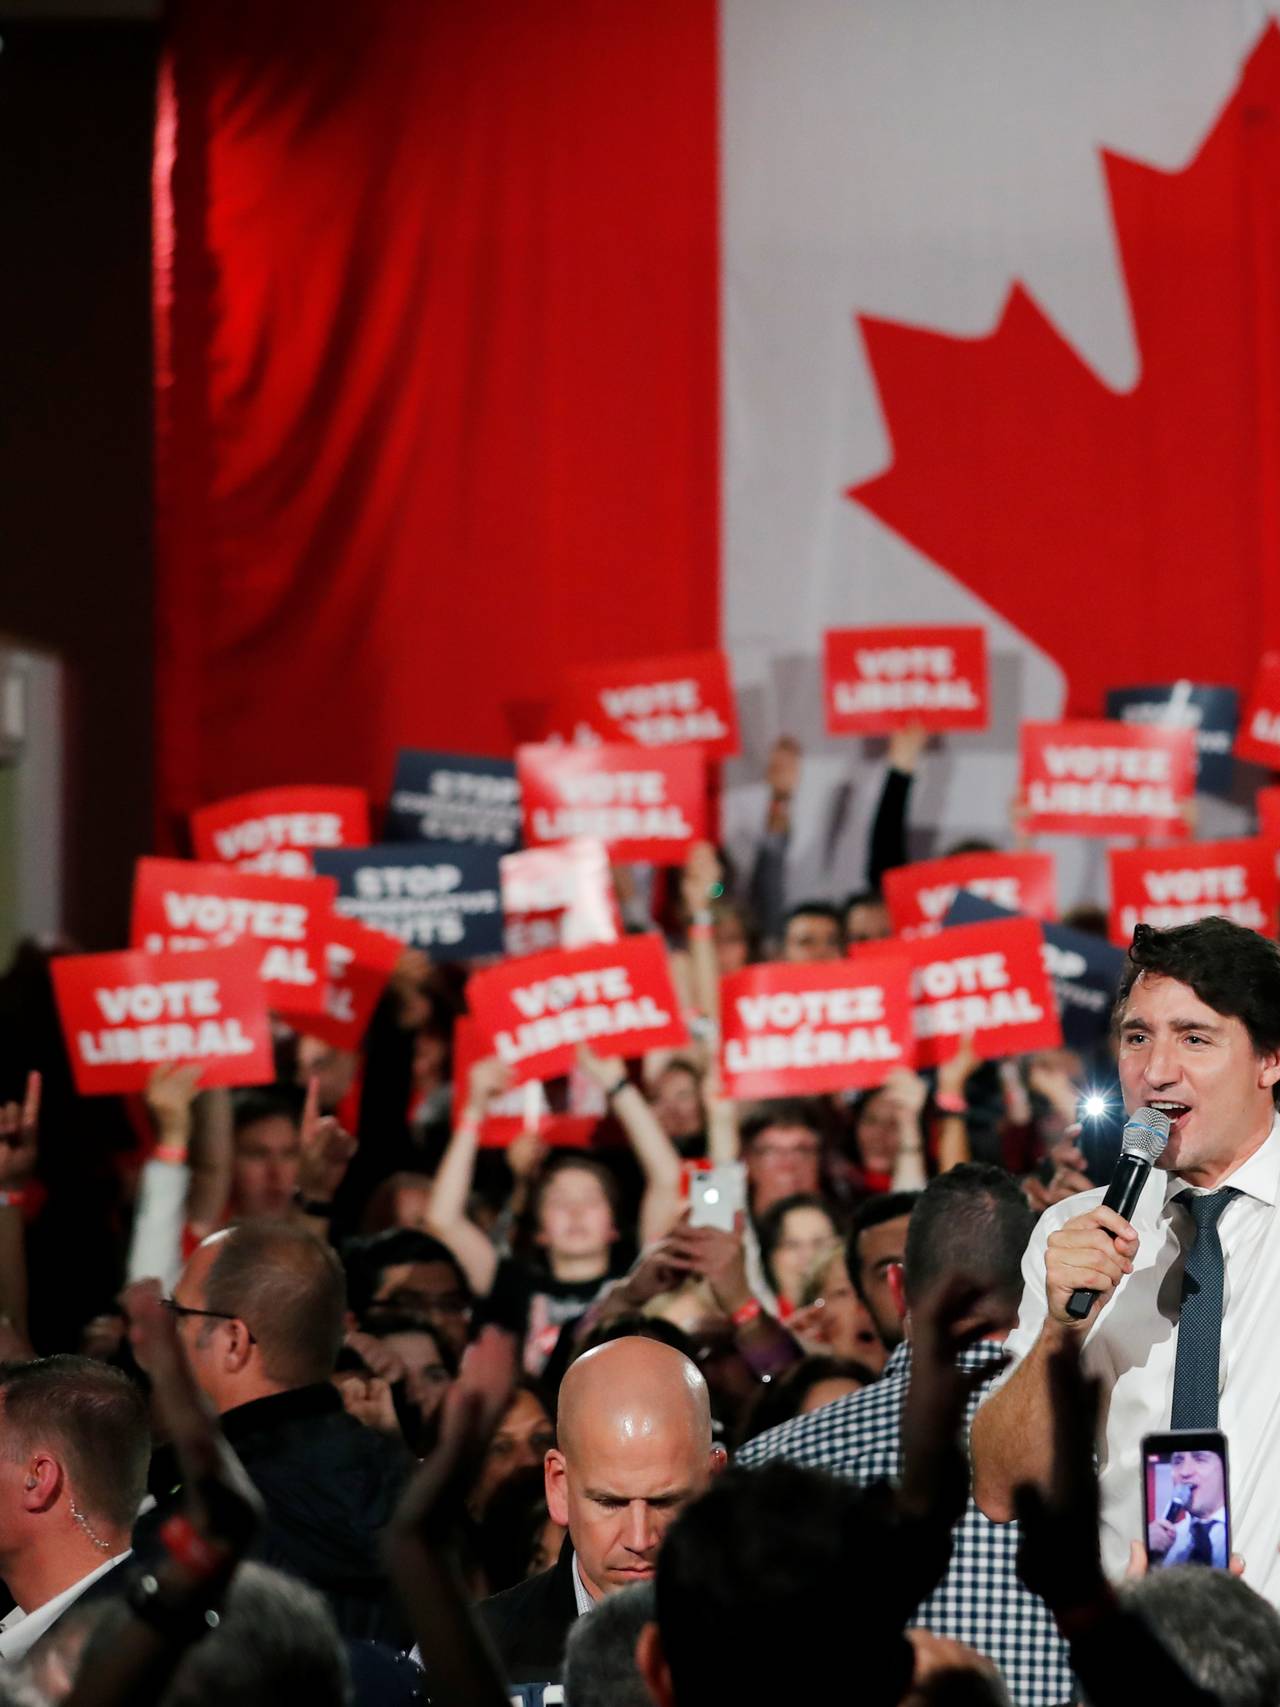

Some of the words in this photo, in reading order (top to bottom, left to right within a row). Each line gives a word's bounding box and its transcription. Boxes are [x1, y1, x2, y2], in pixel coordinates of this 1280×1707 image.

[855, 645, 954, 678] VOTE
[600, 679, 700, 718] VOTE
[833, 681, 980, 713] LIBERAL
[1041, 747, 1172, 781] VOTEZ
[1029, 780, 1180, 818] LIBÉRAL
[213, 812, 343, 860] VOTEZ
[354, 863, 462, 897] STOP
[1143, 865, 1249, 901] VOTE
[162, 892, 309, 942] VOTEZ
[95, 979, 221, 1023] VOTE
[510, 965, 633, 1018] VOTE
[735, 985, 886, 1032] VOTEZ
[78, 1018, 255, 1067] LIBERAL
[494, 995, 672, 1065] LIBERAL
[724, 1022, 903, 1074] LIBÉRAL
